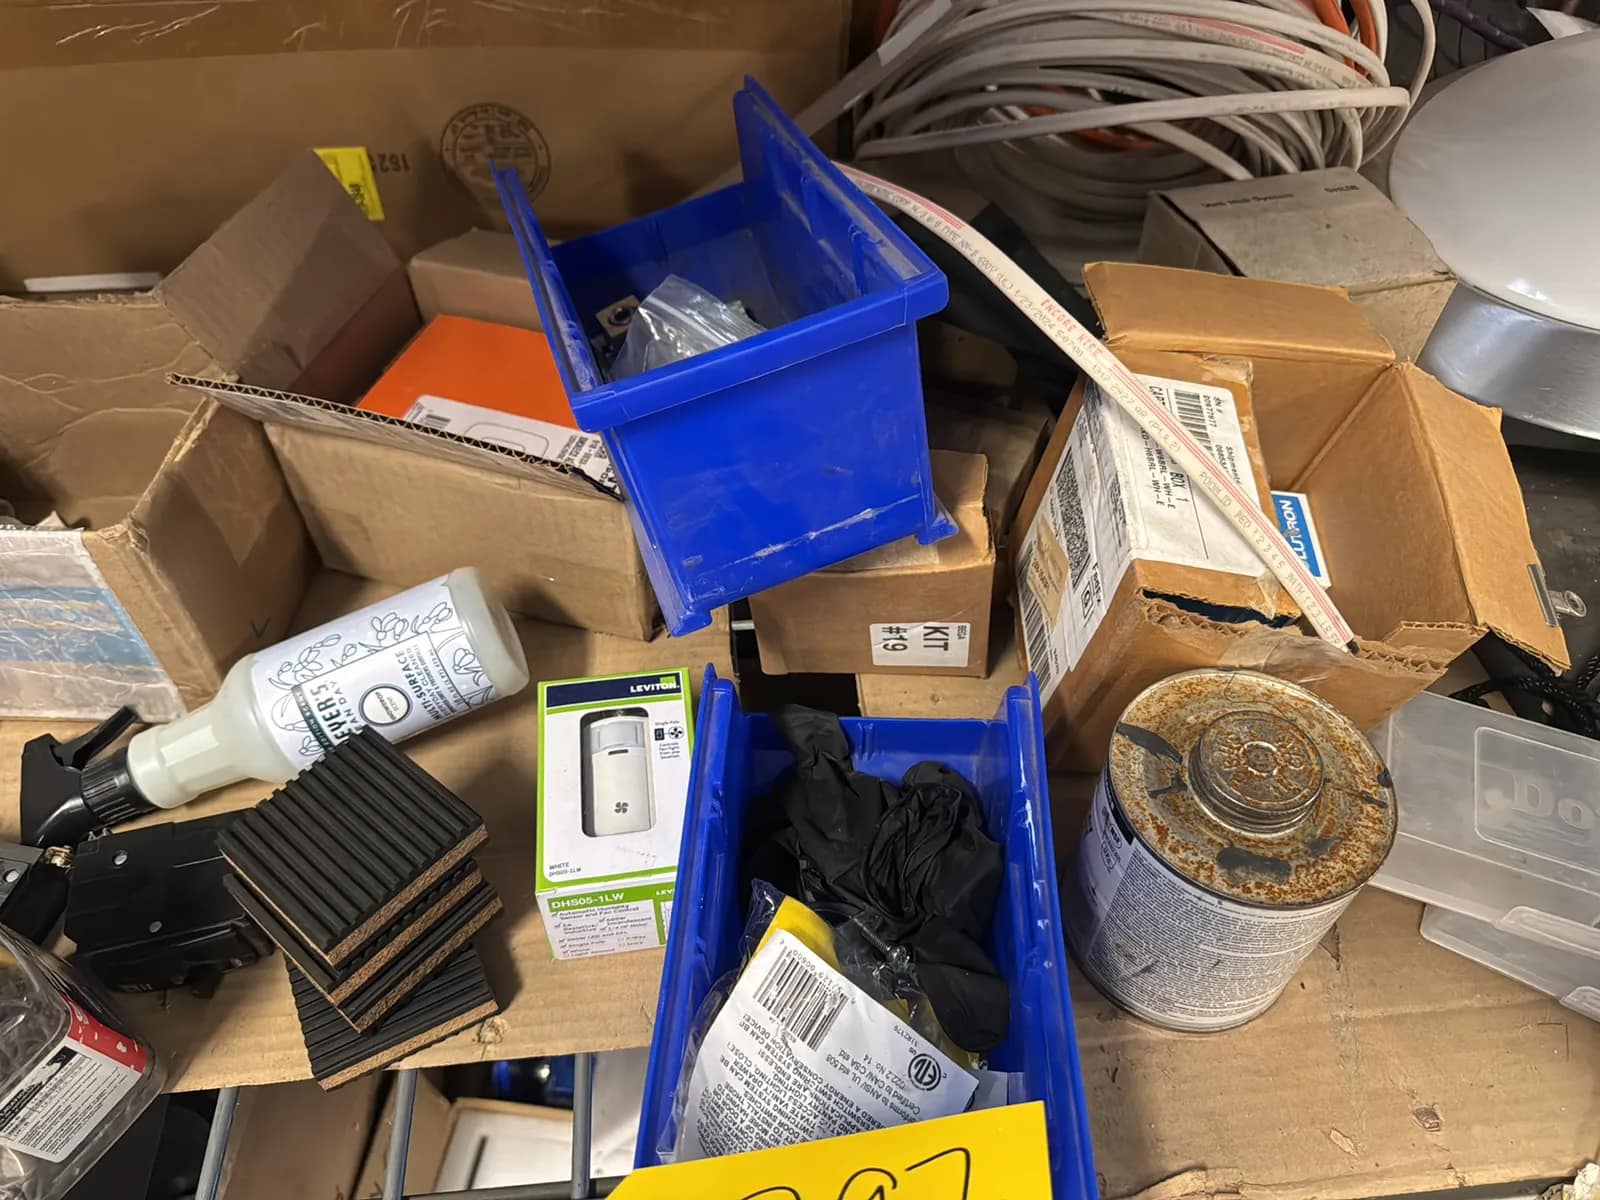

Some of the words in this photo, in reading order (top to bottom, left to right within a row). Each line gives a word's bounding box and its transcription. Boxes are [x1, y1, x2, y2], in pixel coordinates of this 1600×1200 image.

[1168, 469, 1186, 491] BOX
[923, 626, 948, 650] KIT
[630, 682, 680, 694] LEVITON
[552, 892, 624, 909] DHS05-1LW
[741, 1012, 771, 1040] DEVICE!
[763, 1042, 793, 1069] SYSTEM
[768, 1036, 824, 1084] CONSERVATION
[848, 1057, 868, 1074] CSA
[732, 1058, 764, 1088] DRAWER
[742, 1078, 773, 1105] SYSTEM
[823, 1081, 855, 1108] ENERGY
